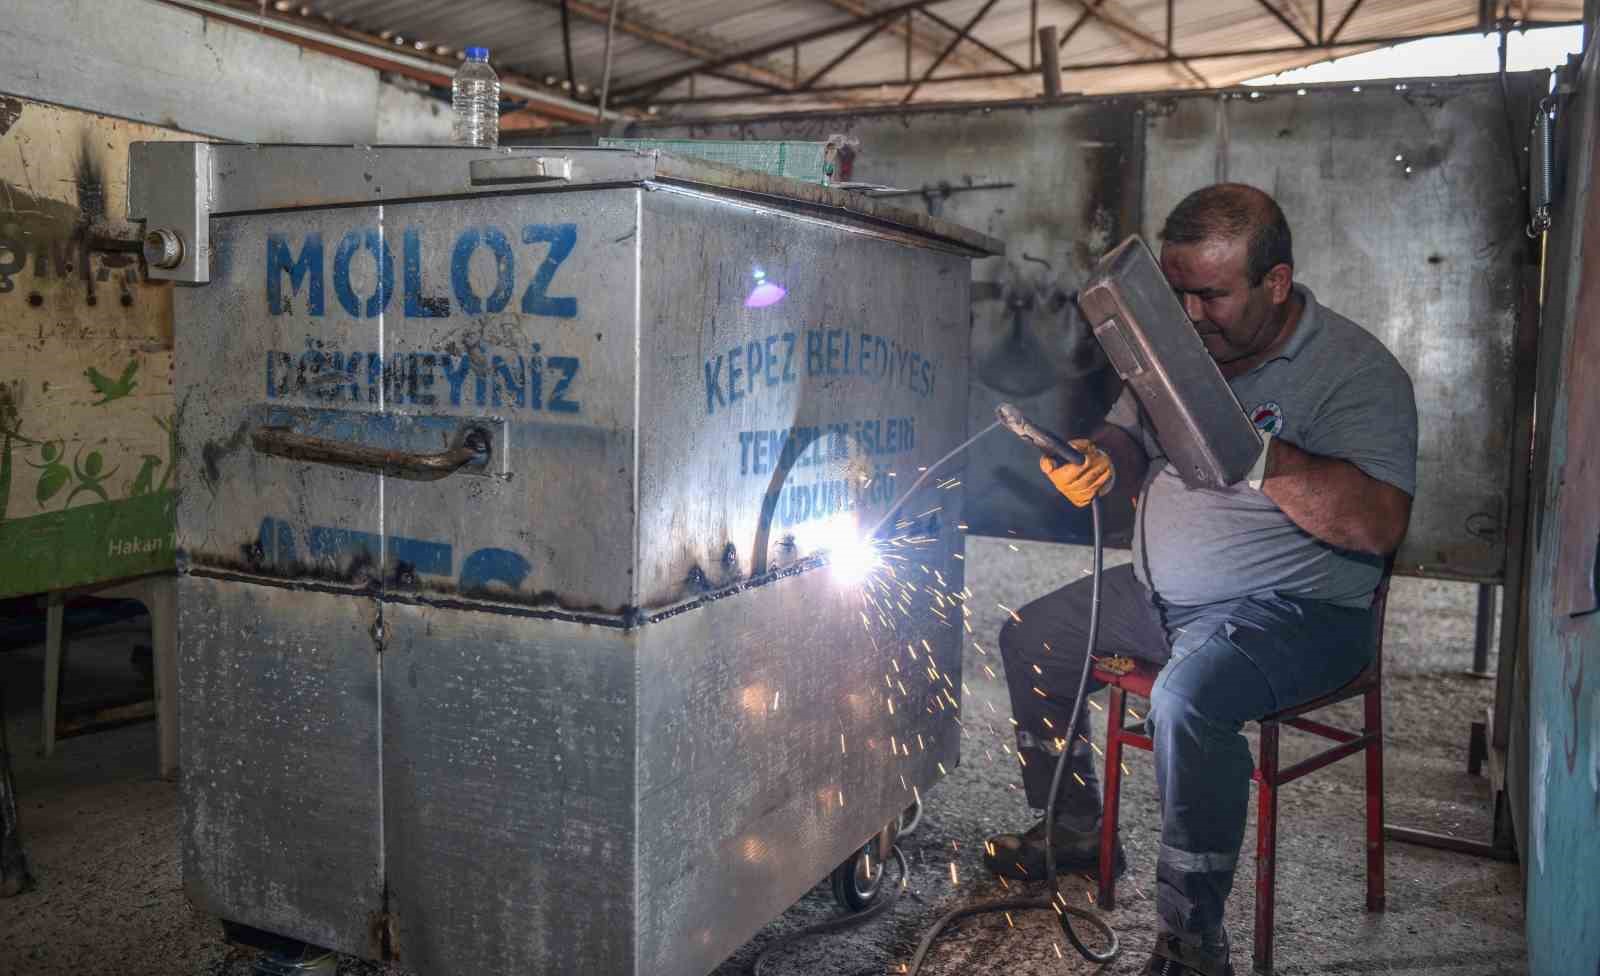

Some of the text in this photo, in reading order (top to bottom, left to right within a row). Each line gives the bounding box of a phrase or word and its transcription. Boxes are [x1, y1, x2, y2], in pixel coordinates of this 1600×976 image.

[265, 223, 578, 319] MOLOZ
[704, 331, 798, 415] KEPEZ
[108, 535, 163, 558] Hakan
